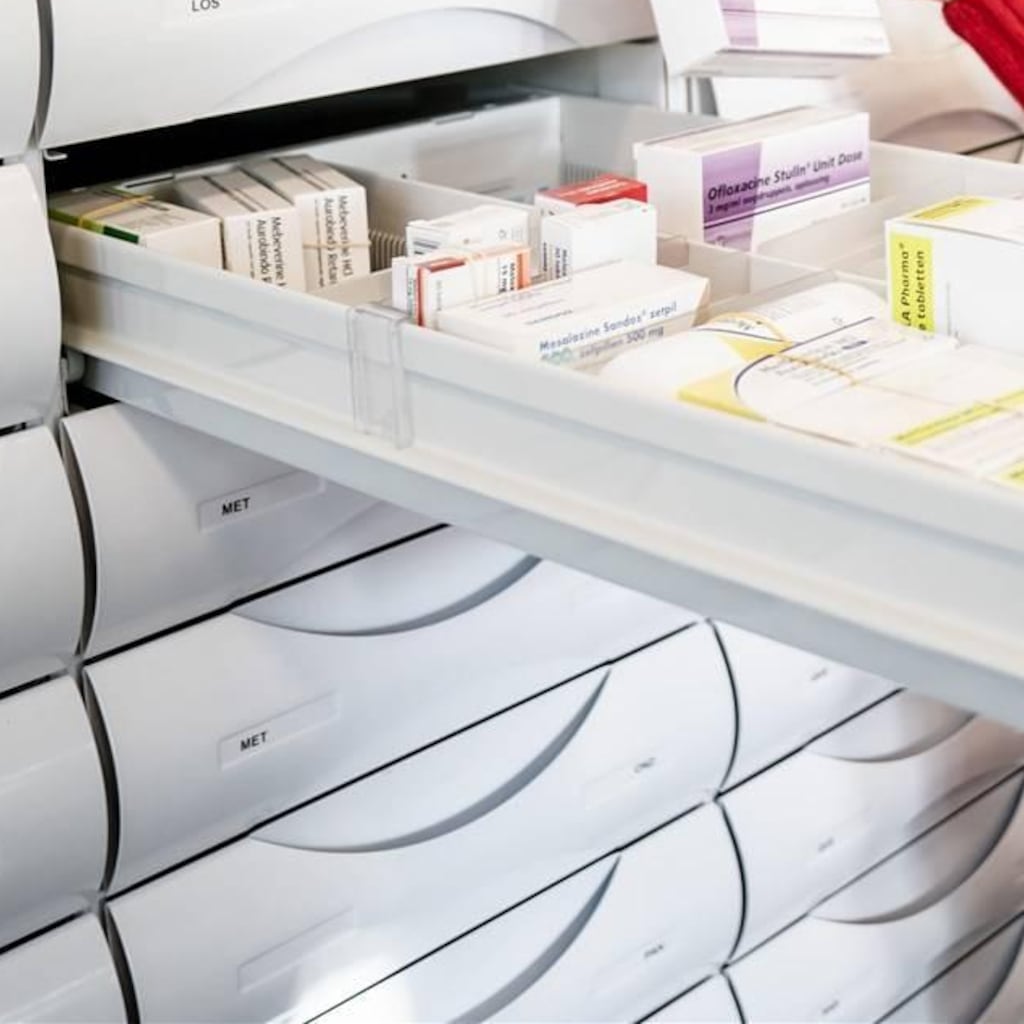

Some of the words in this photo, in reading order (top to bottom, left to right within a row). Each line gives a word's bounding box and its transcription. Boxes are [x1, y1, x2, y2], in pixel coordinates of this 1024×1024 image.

[707, 174, 772, 201] Ofloxacine
[811, 156, 836, 173] Unit
[837, 150, 864, 166] Dose
[256, 219, 270, 275] Aurobindo
[271, 216, 287, 280] Mebeverine
[914, 250, 926, 319] tabletten
[539, 326, 601, 353] Mesalazine
[222, 497, 252, 516] MET
[240, 730, 269, 751] MET
